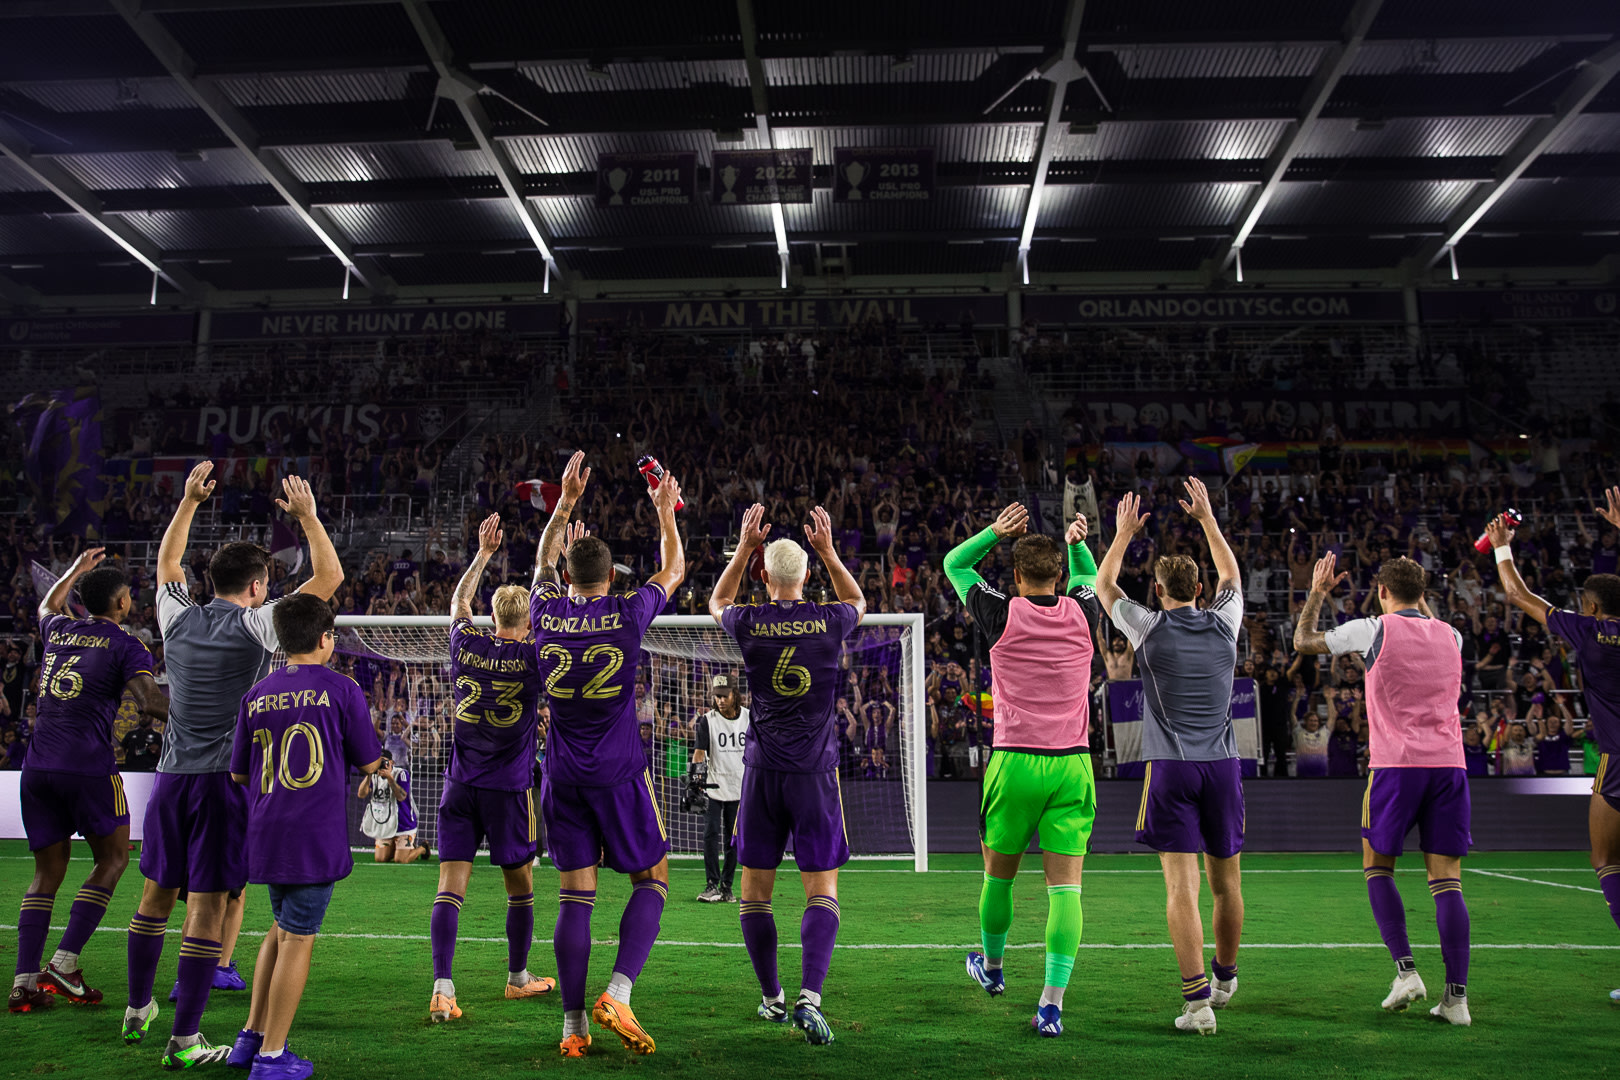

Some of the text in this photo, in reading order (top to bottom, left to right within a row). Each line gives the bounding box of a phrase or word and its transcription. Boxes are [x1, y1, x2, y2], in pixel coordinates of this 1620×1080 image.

[642, 168, 680, 182] 2011
[755, 166, 797, 180] 2022
[880, 163, 919, 177] 2013
[639, 187, 681, 195] USL PRO
[869, 190, 929, 200] CHAMPIONS
[878, 182, 921, 190] USL PRO
[631, 195, 689, 205] CHAMPIONS
[665, 302, 744, 327] MAN
[757, 302, 817, 325] THE
[1078, 297, 1350, 318] ORLANDOCITYSC.COM
[261, 311, 507, 335] NEVER HUNT ALONE
[196, 404, 381, 445] RUCKUS
[541, 612, 623, 633] GONZÁLEZ
[750, 619, 827, 637] JANSSON
[38, 653, 83, 700] 16
[540, 643, 625, 699] 22
[771, 646, 812, 697] 6
[248, 689, 331, 719] PEREYRA
[455, 675, 524, 728] 23
[718, 731, 746, 748] 016
[253, 721, 324, 794] 10
